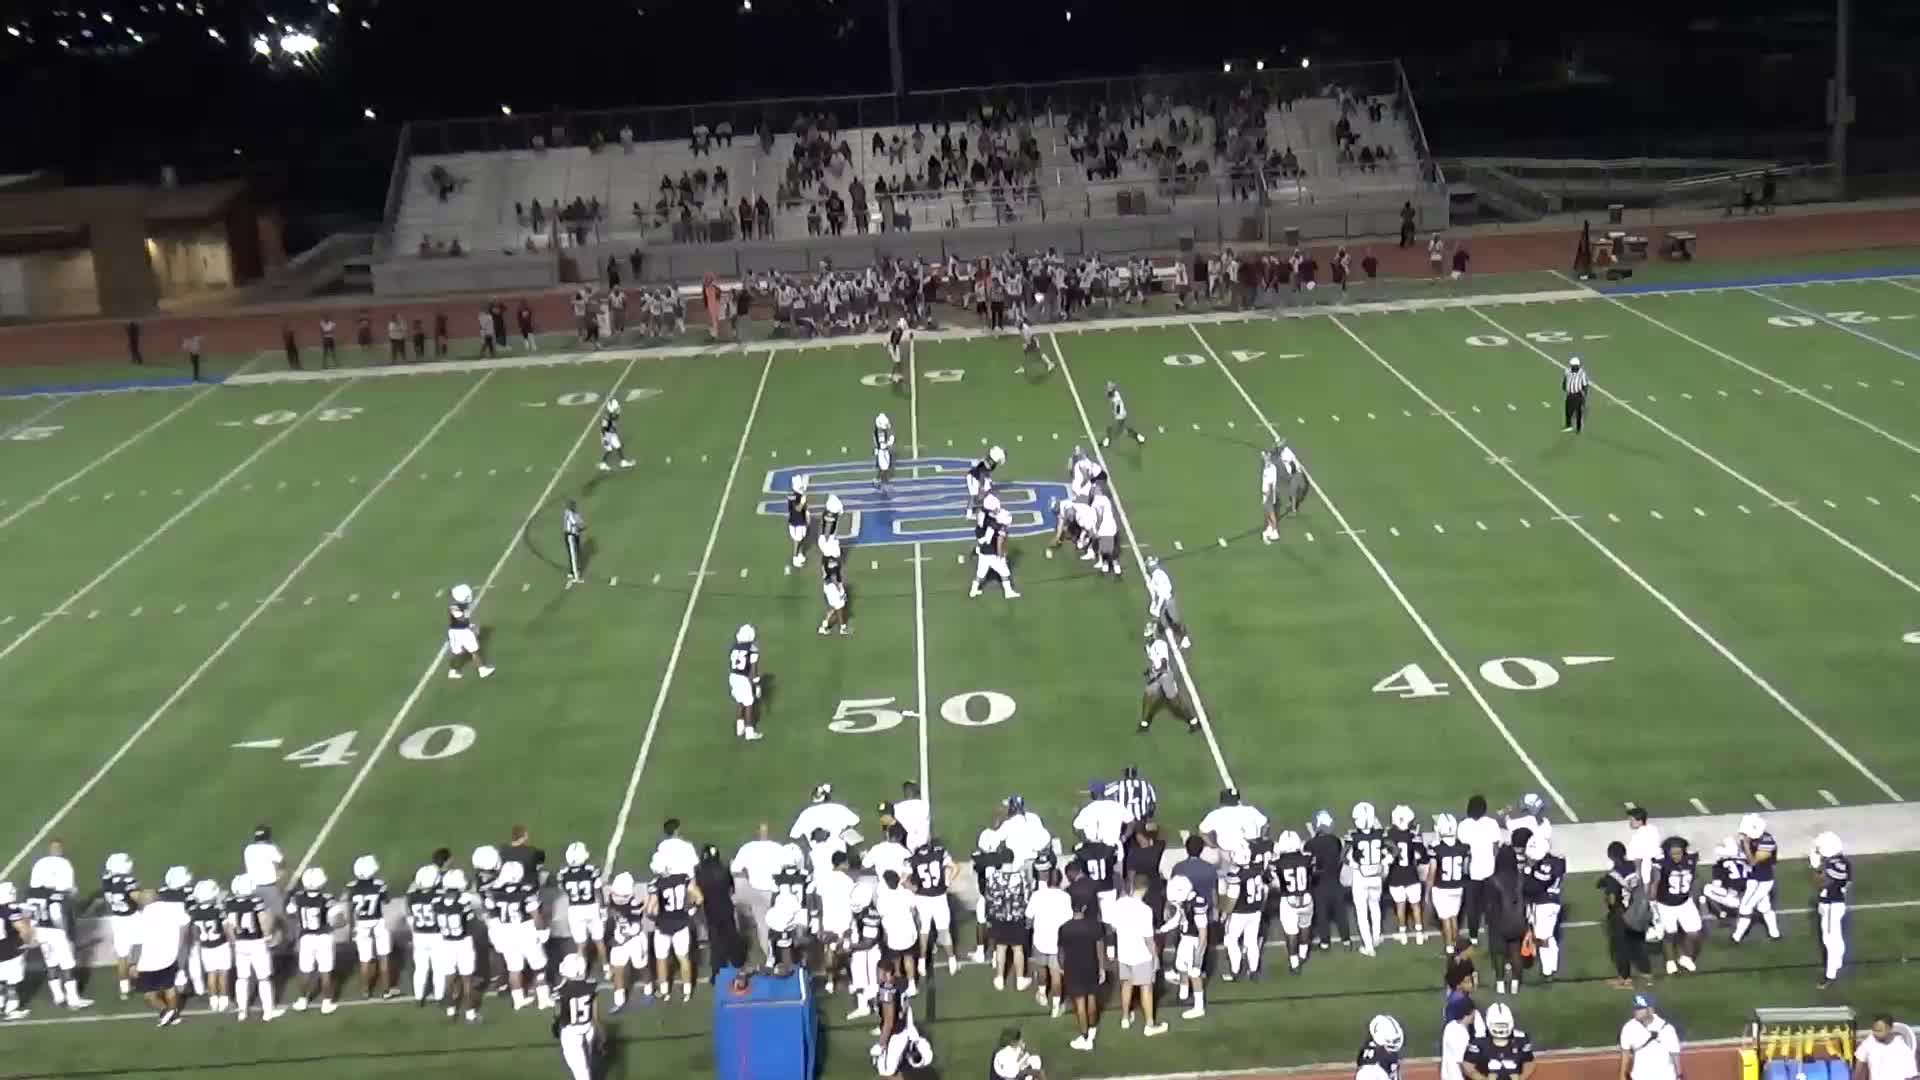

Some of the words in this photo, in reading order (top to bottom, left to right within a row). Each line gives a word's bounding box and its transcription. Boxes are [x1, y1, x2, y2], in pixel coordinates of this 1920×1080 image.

[1283, 866, 1307, 892] 50
[352, 894, 380, 916] 27
[569, 995, 592, 1025] 15
